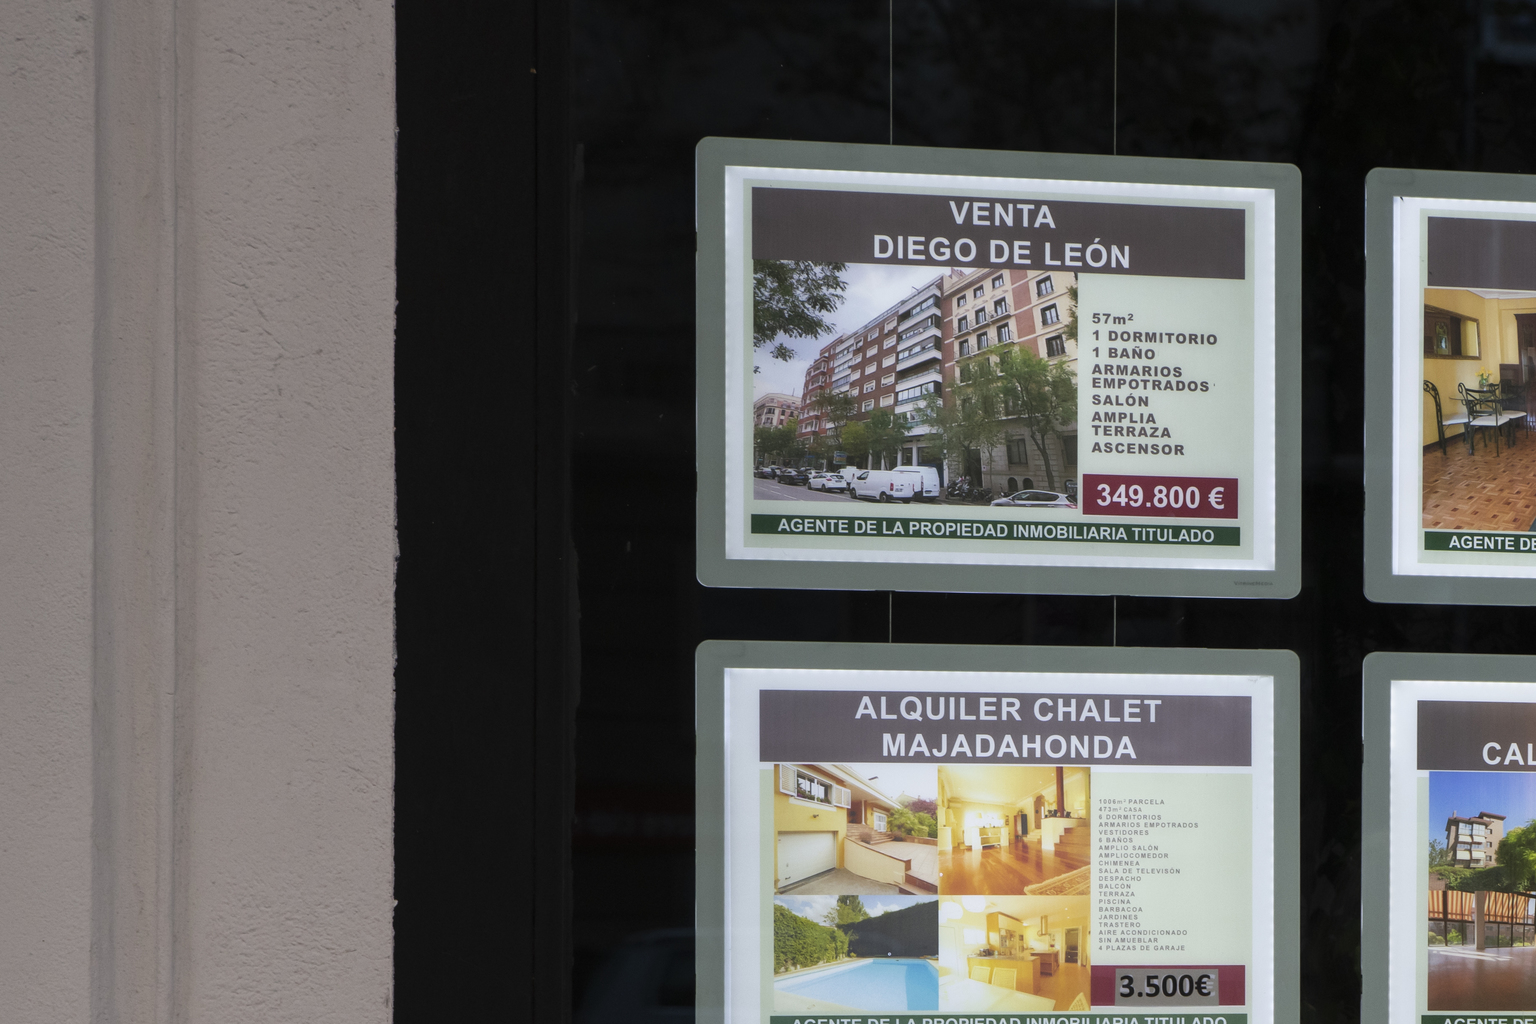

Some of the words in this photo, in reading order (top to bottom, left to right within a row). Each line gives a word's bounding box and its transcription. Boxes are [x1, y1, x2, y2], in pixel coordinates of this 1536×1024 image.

[949, 201, 1056, 228] VENTA
[874, 235, 976, 262] DIEGO
[990, 240, 1031, 264] DE
[1045, 238, 1129, 268] LEÓN
[1093, 330, 1099, 341] 1
[1108, 330, 1217, 345] DORMITORIO
[1092, 347, 1099, 358] 1
[1108, 346, 1155, 360] BAÑO
[1092, 364, 1182, 378] ARMARIOS
[1092, 377, 1209, 392] EMPOTRADOS
[1092, 393, 1149, 407] SALÓN
[1092, 411, 1156, 424] AMPLIA
[1092, 425, 1171, 438] TERRAZA
[1092, 442, 1185, 456] ASCENSOR
[1097, 484, 1200, 509] 349.800
[1208, 487, 1224, 509] €
[778, 518, 849, 533] AGENTE
[855, 520, 877, 534] DE
[883, 521, 905, 534] LA
[909, 522, 1008, 537] PROPIEDAD
[1014, 524, 1128, 540] INMOBILIARIA
[1132, 528, 1214, 542] TITULADO
[855, 696, 1022, 722] ALQUILER
[1034, 698, 1162, 722] CHALET
[883, 733, 1137, 759] MAJADAHONDA
[1120, 974, 1211, 998] 3.500€
